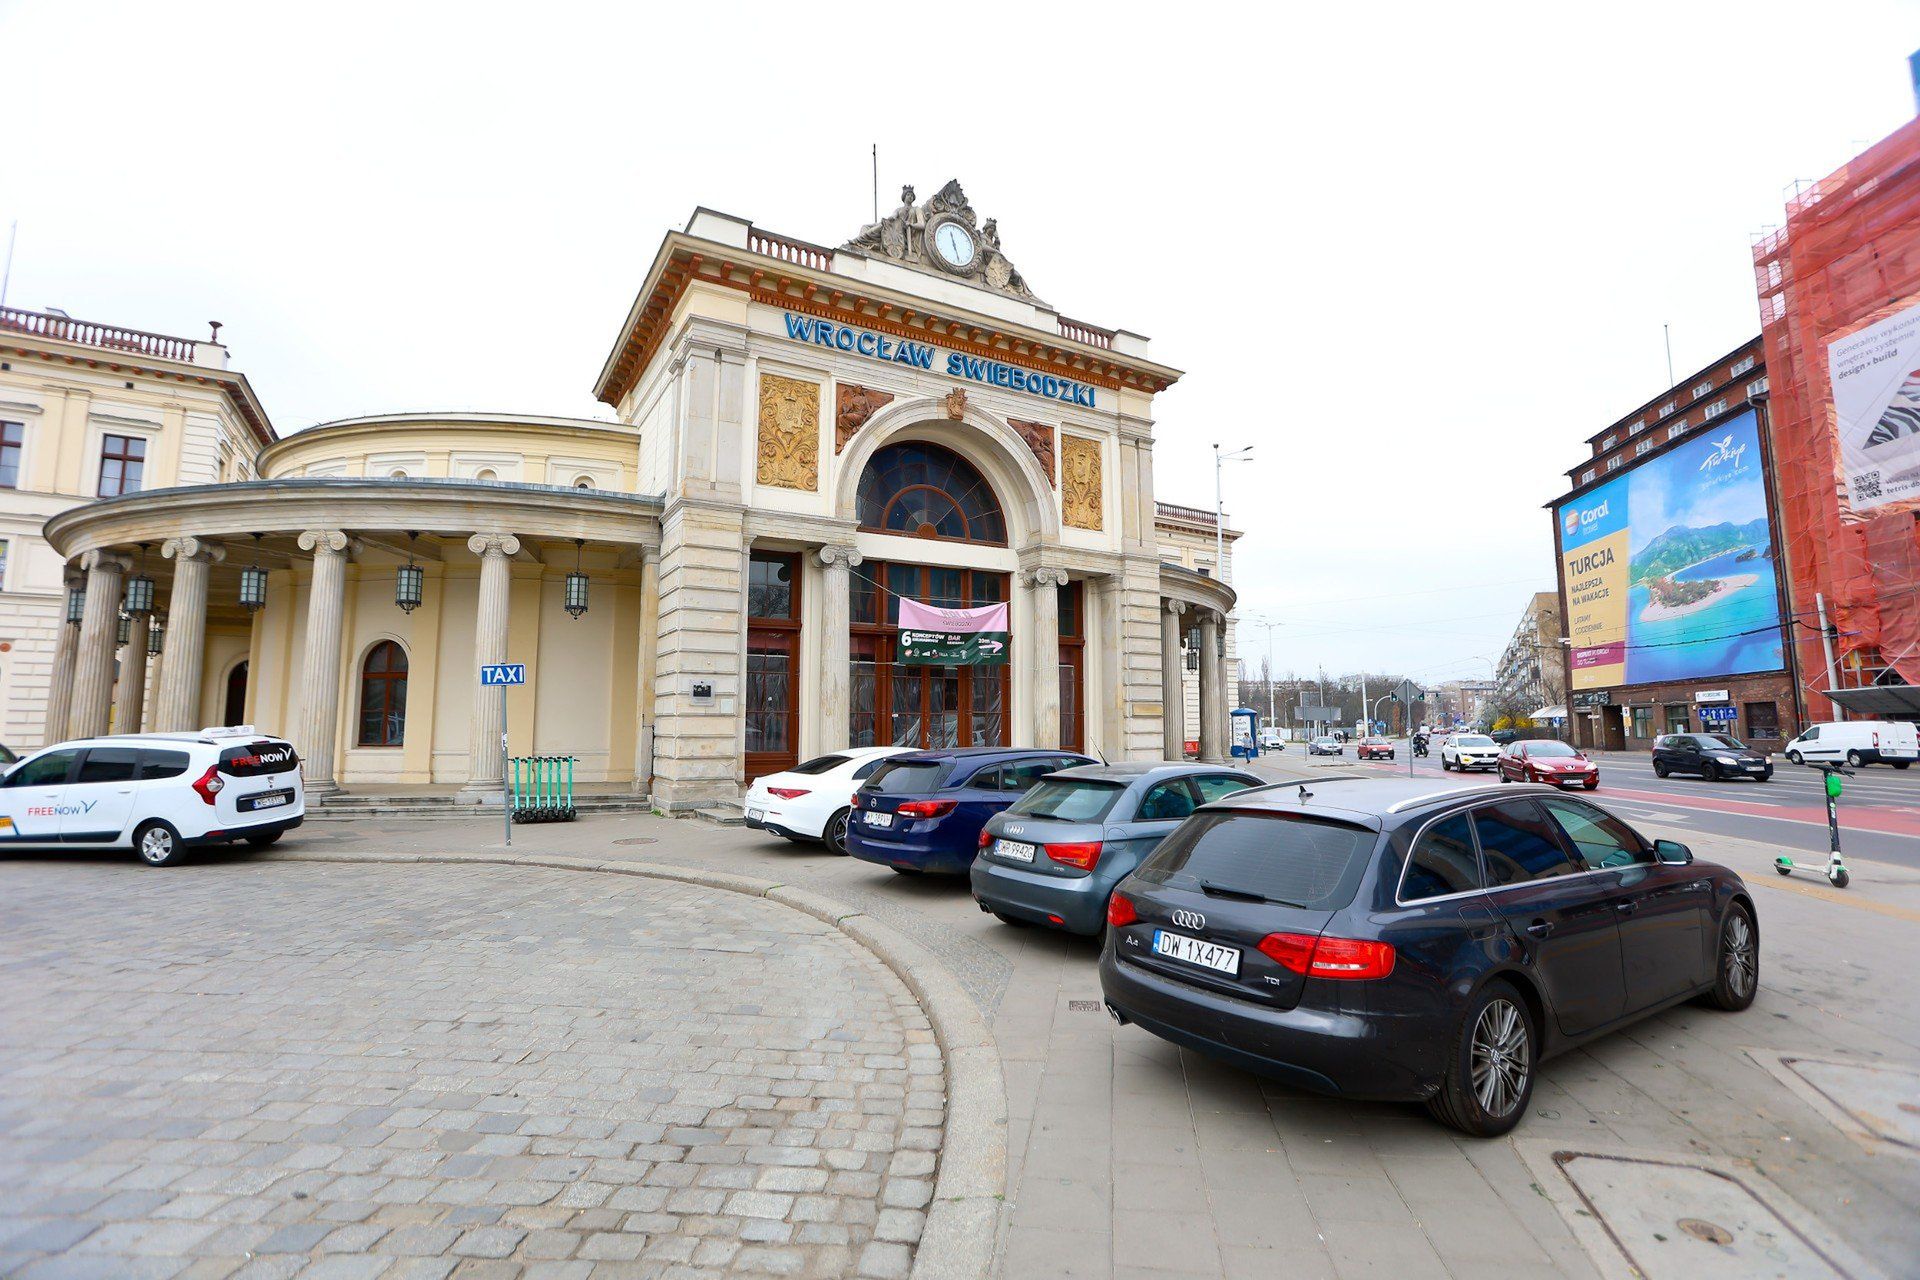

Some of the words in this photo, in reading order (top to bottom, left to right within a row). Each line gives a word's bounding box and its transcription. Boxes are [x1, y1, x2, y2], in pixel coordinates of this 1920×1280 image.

[784, 312, 935, 370] WROCŁAW
[1838, 362, 1866, 380] design
[1872, 348, 1898, 364] build
[1580, 499, 1610, 525] Coral
[1569, 548, 1614, 577] TURCJA
[1571, 577, 1603, 594] NAJLEPSZA
[1572, 597, 1581, 607] NA
[1581, 588, 1610, 604] WAKACJE
[901, 631, 912, 646] 6
[483, 666, 524, 683] TAXI
[1125, 935, 1139, 947] A4
[1161, 934, 1181, 956] DW
[1187, 940, 1235, 971] 1X477
[1264, 975, 1280, 986] TDI
